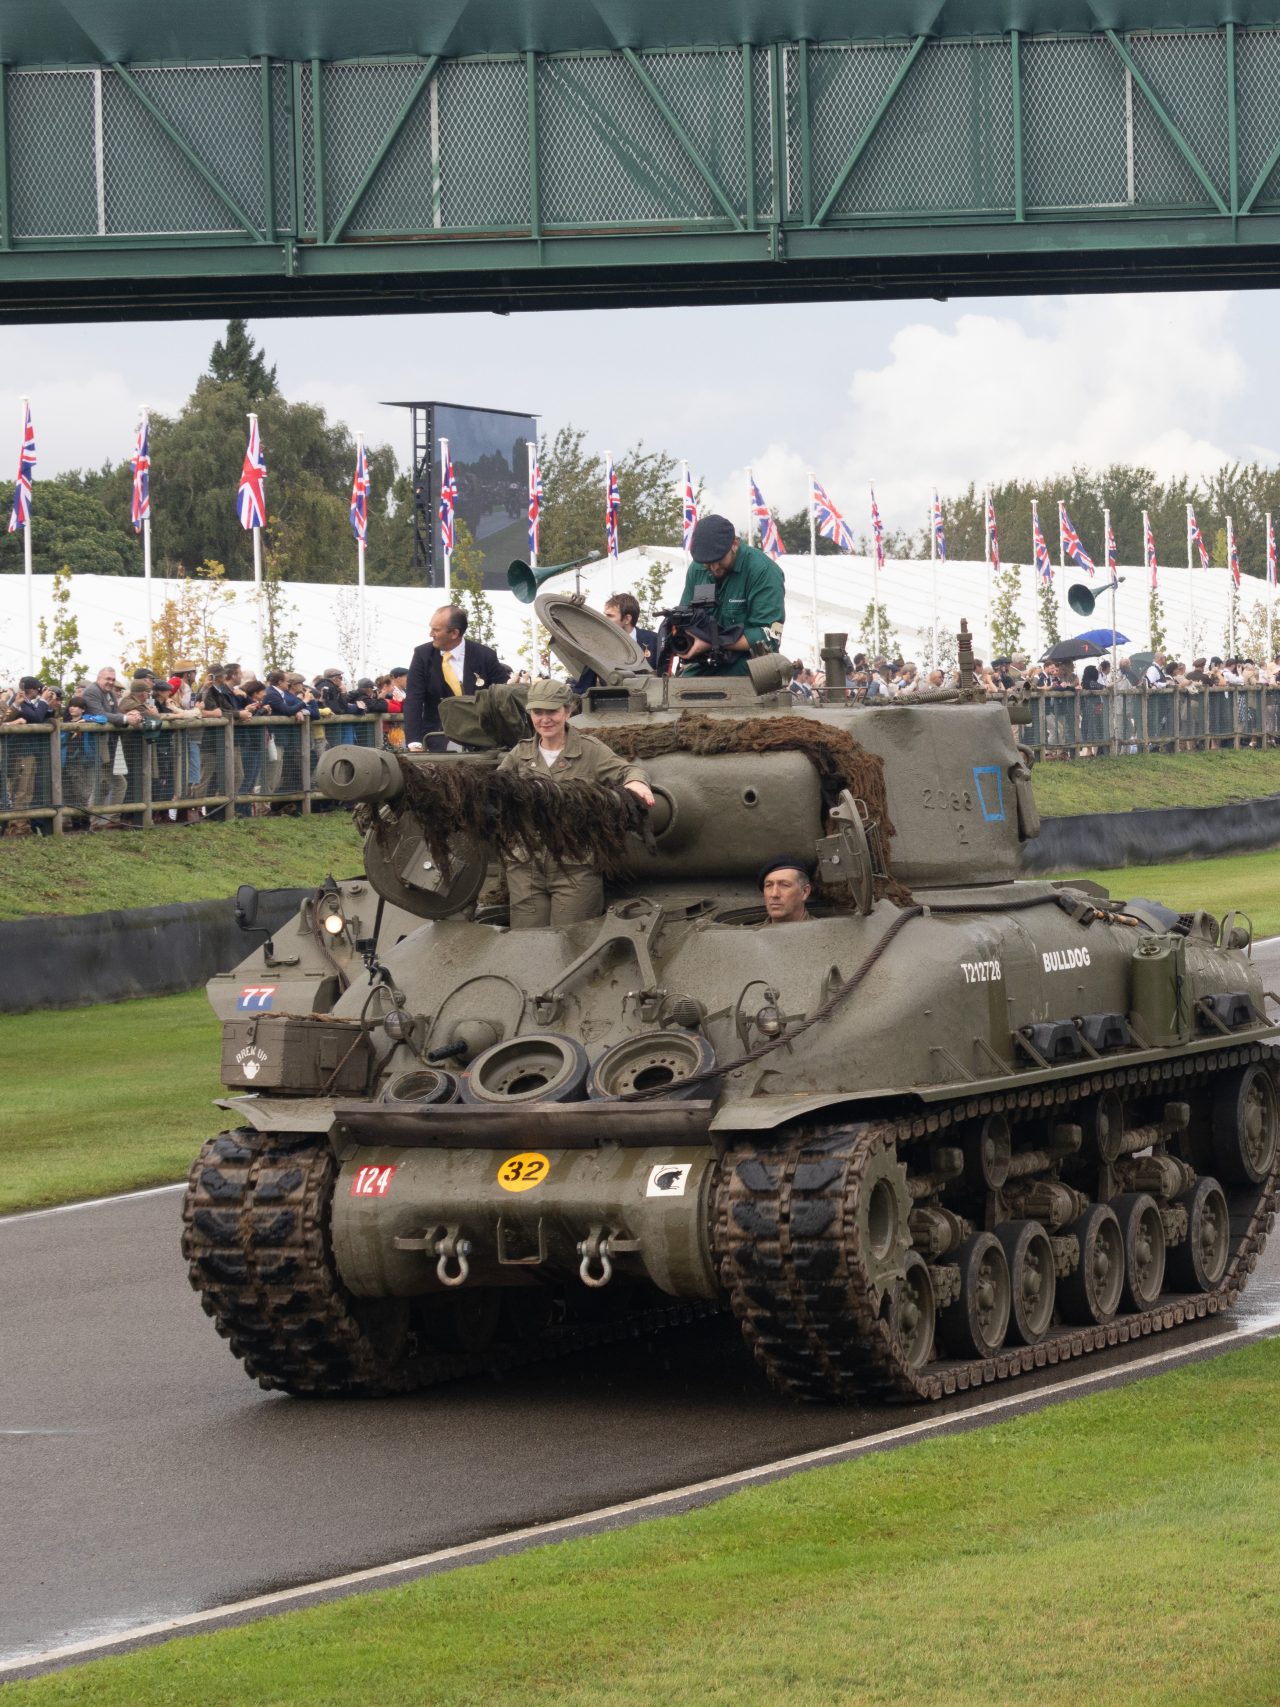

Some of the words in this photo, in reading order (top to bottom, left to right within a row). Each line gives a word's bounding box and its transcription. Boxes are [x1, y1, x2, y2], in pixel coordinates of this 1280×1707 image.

[1042, 946, 1091, 973] BULLDOG
[960, 961, 1001, 983] T212728
[242, 987, 275, 1007] 77
[355, 1167, 392, 1194] 124
[503, 1160, 545, 1181] 32
